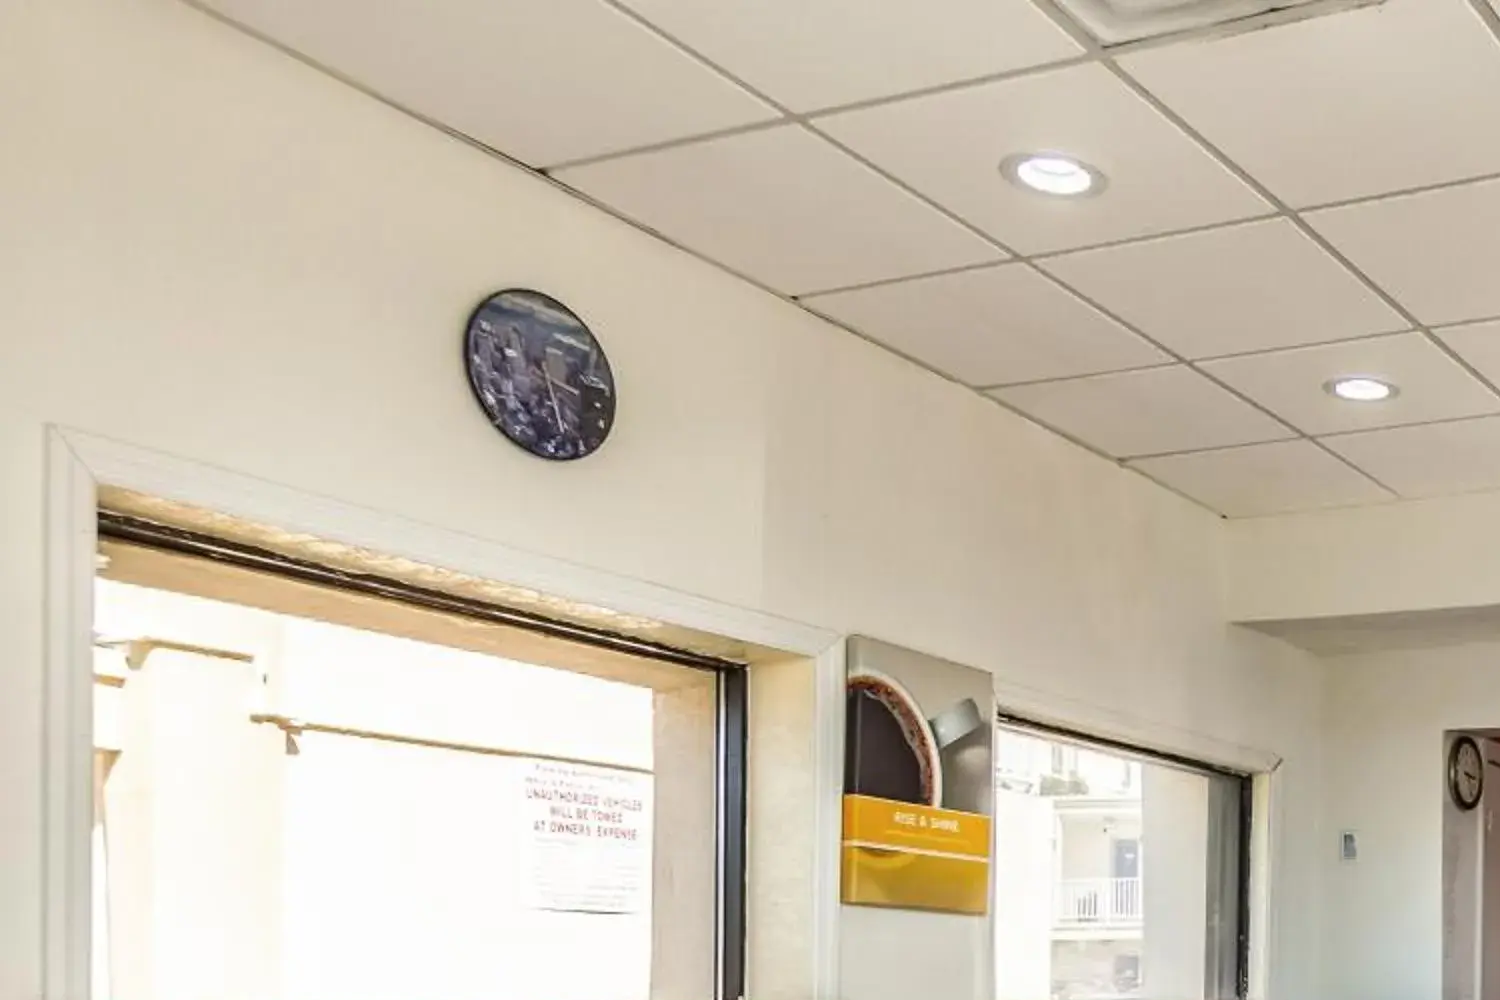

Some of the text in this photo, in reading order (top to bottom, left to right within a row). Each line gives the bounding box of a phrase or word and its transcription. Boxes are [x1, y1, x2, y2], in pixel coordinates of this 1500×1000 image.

[525, 787, 643, 813] UNAUTHORIZED VEHICLES
[549, 805, 623, 824] WILL BE TOWED
[533, 819, 546, 832] AT
